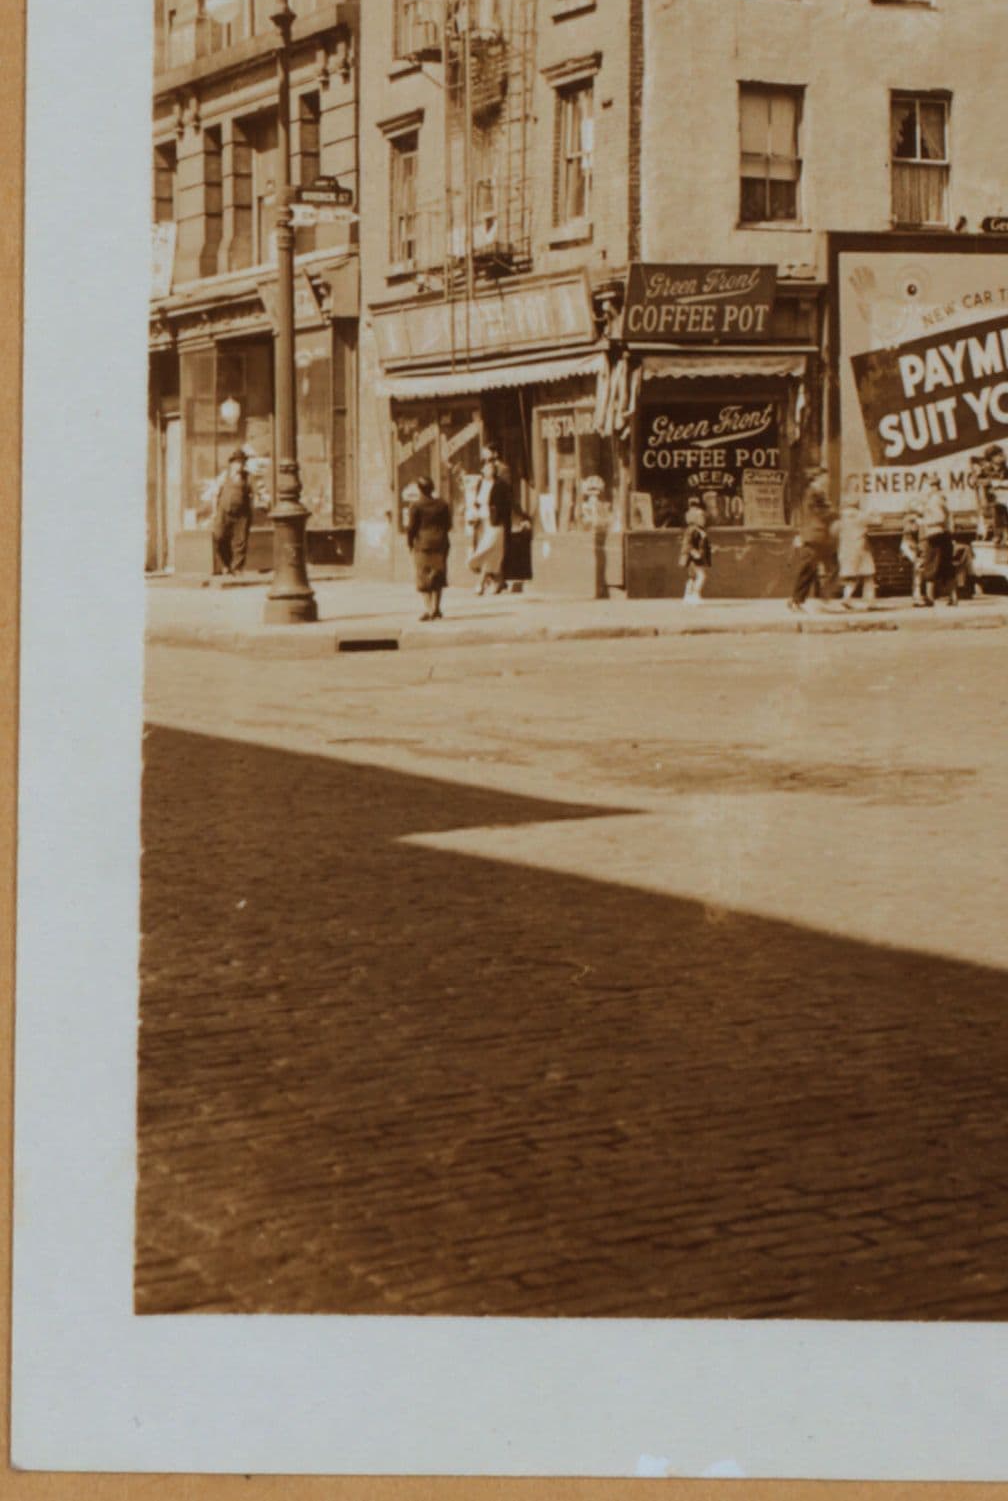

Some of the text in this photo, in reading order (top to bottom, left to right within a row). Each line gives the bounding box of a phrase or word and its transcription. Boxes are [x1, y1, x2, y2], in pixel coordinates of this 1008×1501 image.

[645, 267, 760, 300] Green Front
[627, 303, 769, 333] COFFEE POT
[922, 301, 955, 327] NEW
[961, 290, 993, 309] CAR
[648, 403, 773, 447] Green Front
[878, 394, 959, 459] SUIT
[642, 448, 780, 469] COFFEE POT
[687, 470, 735, 488] BEER
